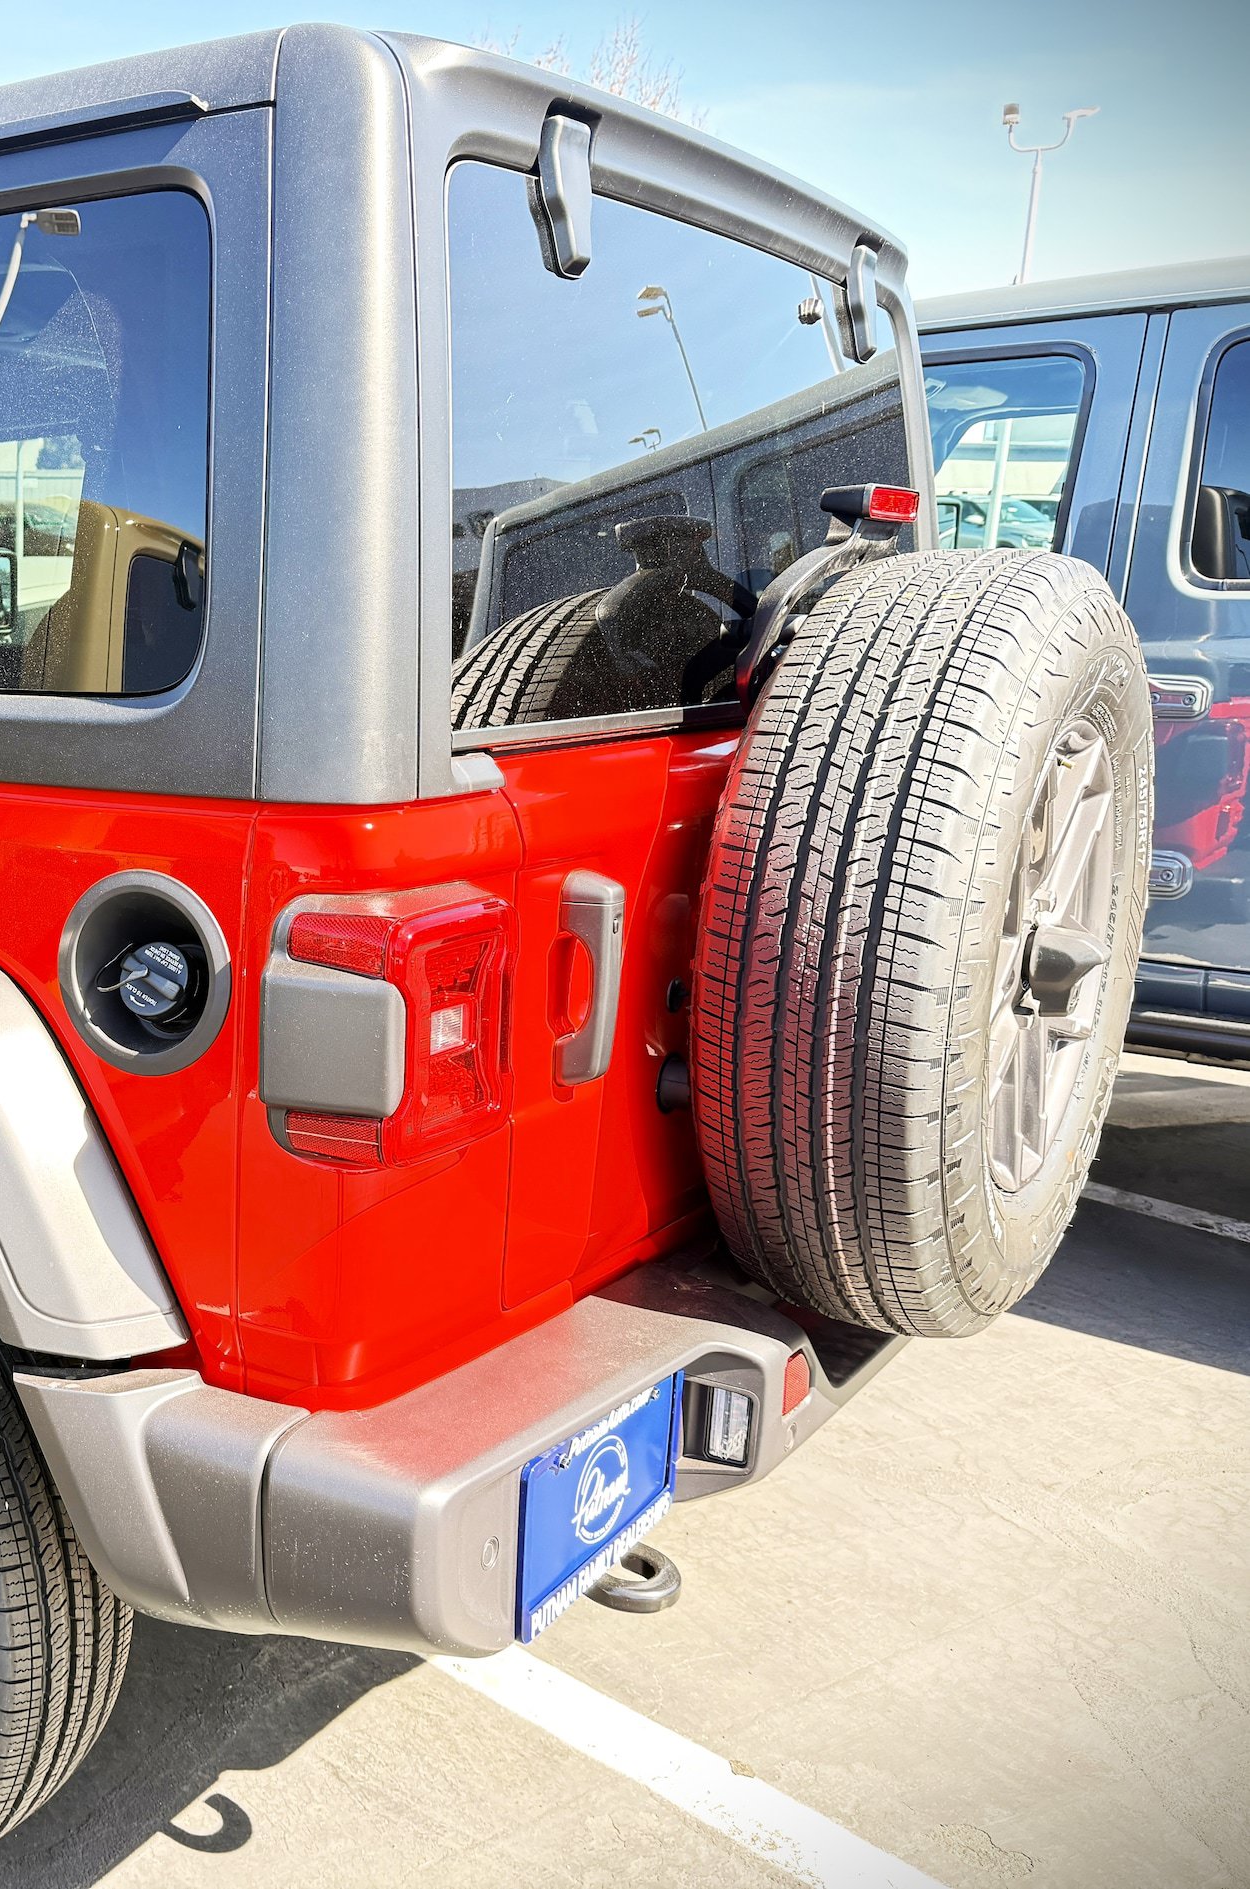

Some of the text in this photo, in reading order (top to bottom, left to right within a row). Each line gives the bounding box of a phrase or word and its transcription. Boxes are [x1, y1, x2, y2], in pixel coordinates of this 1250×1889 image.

[1137, 764, 1147, 865] 245/75R17
[530, 1490, 671, 1639] PUTNAM FAMILY DEALERSHIPS
